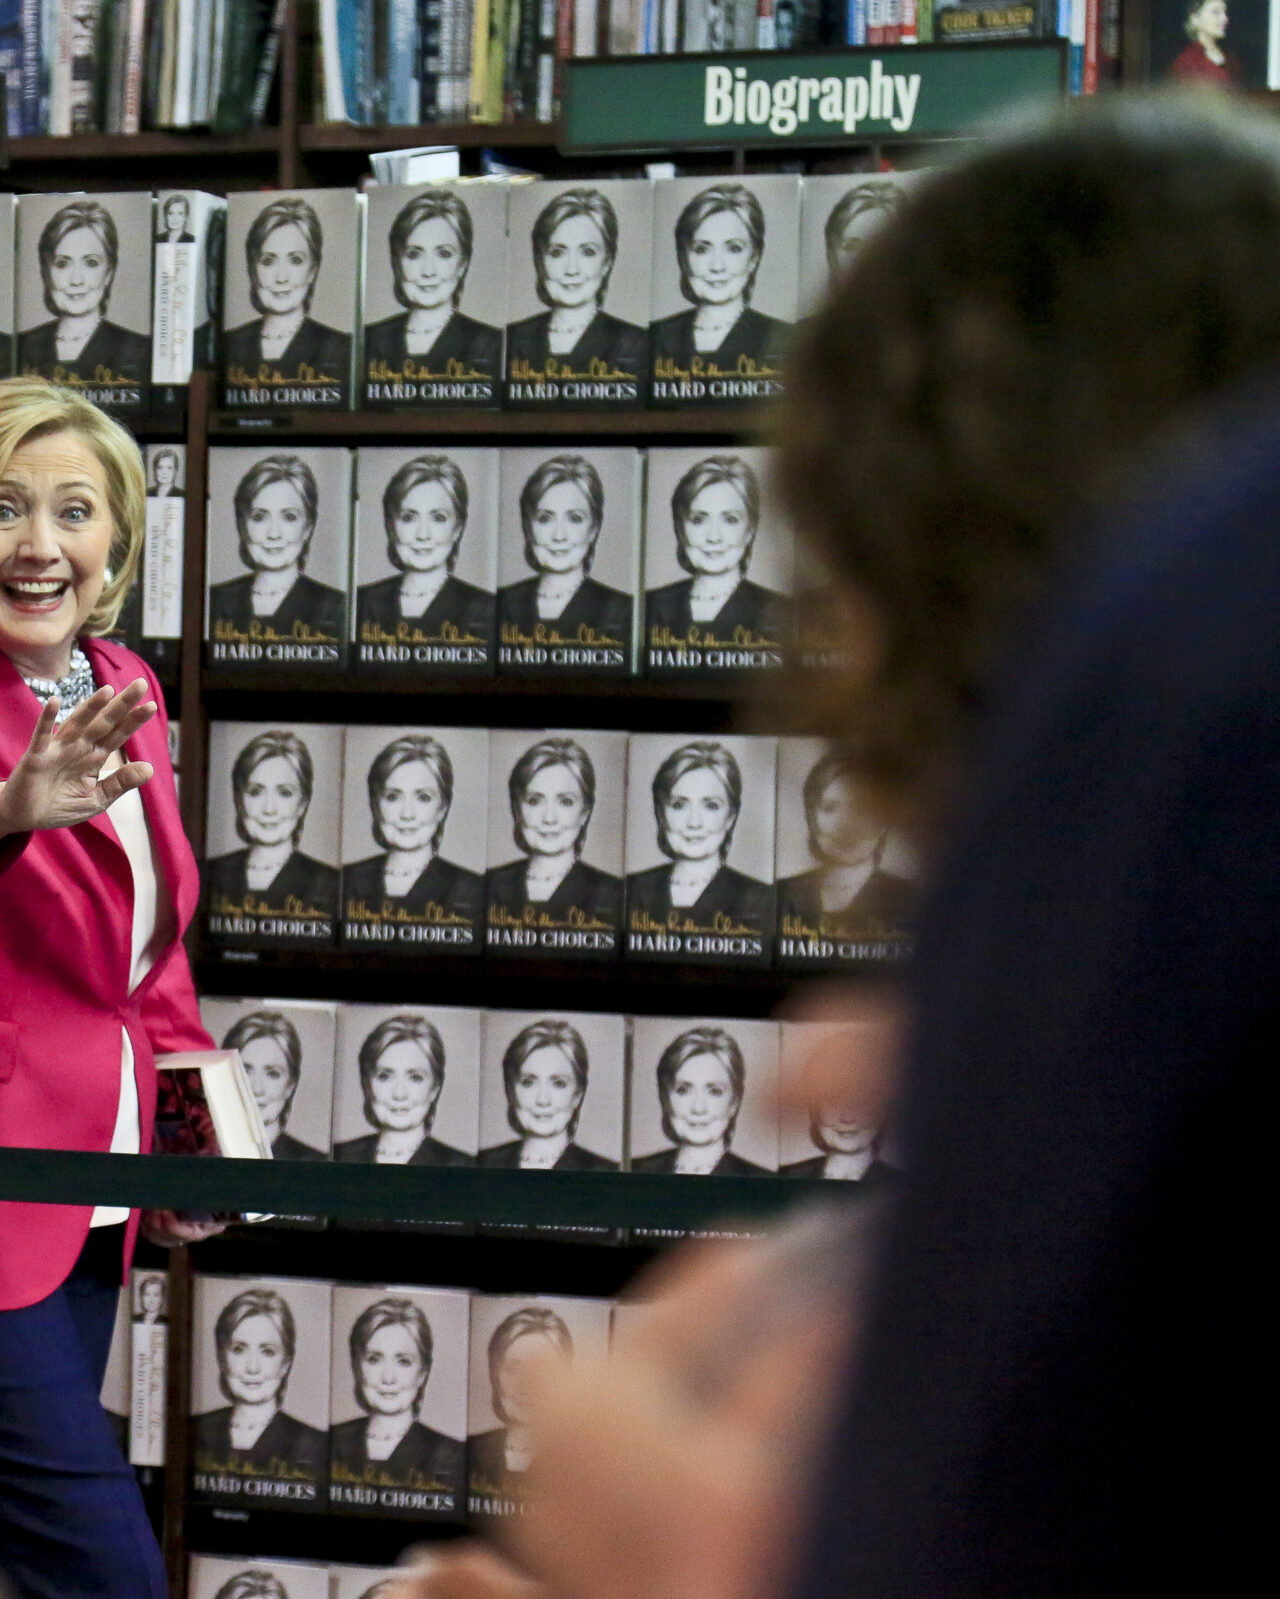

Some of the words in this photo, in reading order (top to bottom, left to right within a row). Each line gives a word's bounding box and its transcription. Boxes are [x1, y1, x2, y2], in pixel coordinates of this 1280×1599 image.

[704, 60, 921, 136] Biography
[81, 388, 140, 404] HOICES
[226, 388, 271, 404] HARD
[273, 387, 341, 403] CHOICES
[367, 383, 417, 400] HARD
[421, 383, 493, 399] CHOICES
[510, 382, 559, 399] HARD
[563, 383, 637, 399] CHOICES
[653, 381, 706, 398] HARD
[709, 380, 784, 397] CHOICES
[213, 643, 263, 661] HARD
[266, 643, 338, 661] CHOICES
[360, 645, 411, 662] HARD
[414, 646, 488, 663] CHOICES
[499, 647, 548, 665] HARD
[551, 647, 624, 665] CHOICES
[649, 650, 702, 667] HARD
[705, 650, 783, 668] CHOICES
[209, 917, 257, 934] HARD
[259, 918, 332, 937] CHOICES
[345, 922, 395, 941] HARD
[398, 924, 473, 944] CHOICES
[487, 927, 536, 947] HARD
[540, 930, 615, 949] CHOICES
[629, 932, 681, 953] HARD
[685, 935, 762, 956] CHOICES
[781, 938, 834, 957] HARD
[195, 1475, 241, 1494] HARD
[244, 1480, 317, 1500] CHOICES
[329, 1486, 378, 1505] HARD
[380, 1490, 455, 1512] CHOICES
[469, 1497, 516, 1516] HARD
